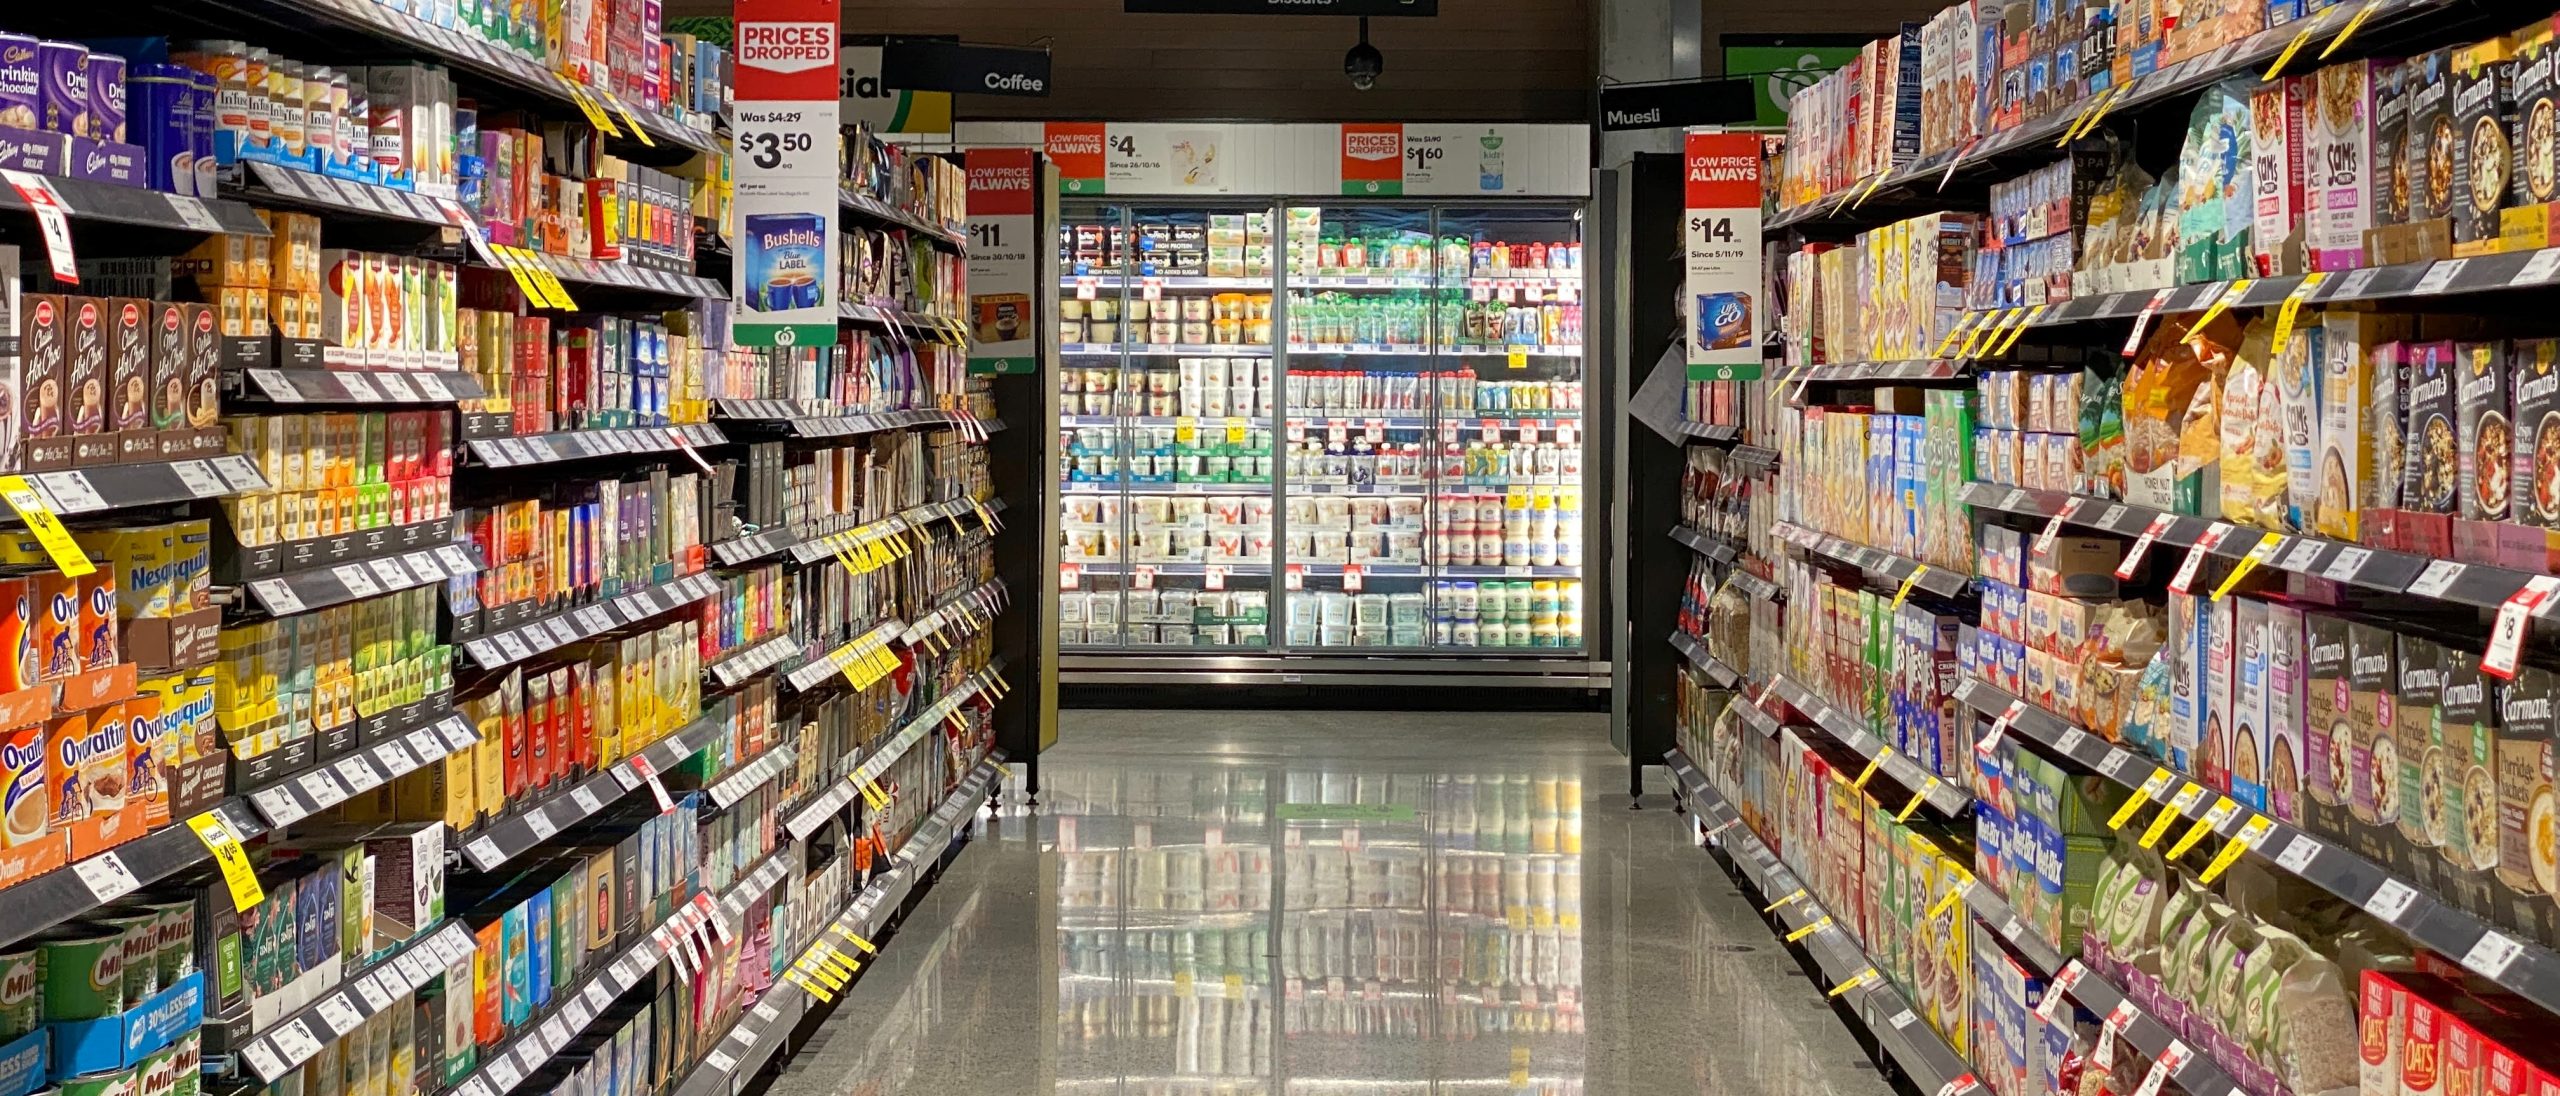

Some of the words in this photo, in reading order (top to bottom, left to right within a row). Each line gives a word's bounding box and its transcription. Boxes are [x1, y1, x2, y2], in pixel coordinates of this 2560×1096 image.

[744, 27, 829, 45] PRICES
[744, 47, 829, 60] DROPPED
[985, 72, 1043, 91] Coffee
[2512, 47, 2551, 101] Carman's
[2453, 67, 2494, 117] Carman's
[741, 112, 766, 122] Was
[768, 112, 801, 122] $4.29
[1607, 108, 1660, 126] Muesli
[1050, 134, 1073, 143] LOW
[1074, 134, 1101, 143] PRICE
[1109, 135, 1136, 158] $4
[1348, 136, 1396, 146] PRICES
[1050, 143, 1101, 154] ALWAYS
[1348, 146, 1396, 154] DROPPED
[1691, 157, 1718, 167] LOW
[1720, 156, 1756, 167] PRICE
[969, 168, 995, 178] LOW
[997, 168, 1030, 178] PRICE
[1690, 168, 1757, 181] ALWAYS
[969, 178, 1031, 190] ALWAYS
[2077, 180, 2083, 190] 3
[2076, 195, 2083, 205] 3
[2076, 210, 2083, 221] 3
[764, 229, 820, 250] Bushells
[970, 223, 1000, 247] $11
[1691, 217, 1733, 243] $14
[784, 251, 801, 260] Blue
[970, 253, 991, 261] Since
[1691, 250, 1714, 258] Since
[1715, 250, 1743, 258] 5/11/19
[779, 259, 806, 270] LABEL
[26, 354, 43, 391] Hot
[42, 344, 61, 373] Choc
[71, 354, 87, 390] Hot
[86, 345, 103, 372] Choc
[115, 353, 130, 387] Hot
[129, 345, 145, 372] Choc
[156, 356, 170, 388] Hot
[169, 347, 184, 373] Choc
[190, 355, 203, 387] Hot
[203, 347, 218, 373] Choc
[2458, 366, 2495, 405] Carman's
[2516, 365, 2558, 405] Carman's
[2144, 477, 2158, 490] HONEY
[2159, 478, 2170, 490] NUT
[2153, 491, 2171, 505] CRUNCH
[197, 624, 219, 640] CHOCOLATE
[2309, 633, 2345, 665] Carman's
[2351, 644, 2388, 677] Carman's
[2441, 671, 2483, 707] Carman's
[203, 763, 225, 780] CHOCOLATE
[2501, 749, 2535, 786] Porridge
[2501, 777, 2530, 803] Sachets
[207, 830, 226, 843] Special
[2036, 840, 2063, 887] Weet-Bix
[159, 919, 193, 945] MILO
[2368, 980, 2383, 996] UNCLE
[164, 997, 183, 1020] LESS
[2413, 1002, 2432, 1020] UNCLE
[2362, 1014, 2385, 1050] OATS
[2450, 1024, 2467, 1043] UNCLE
[2405, 1038, 2434, 1073] OATS
[2493, 1050, 2514, 1071] UNCLE
[2446, 1063, 2471, 1096] OATS
